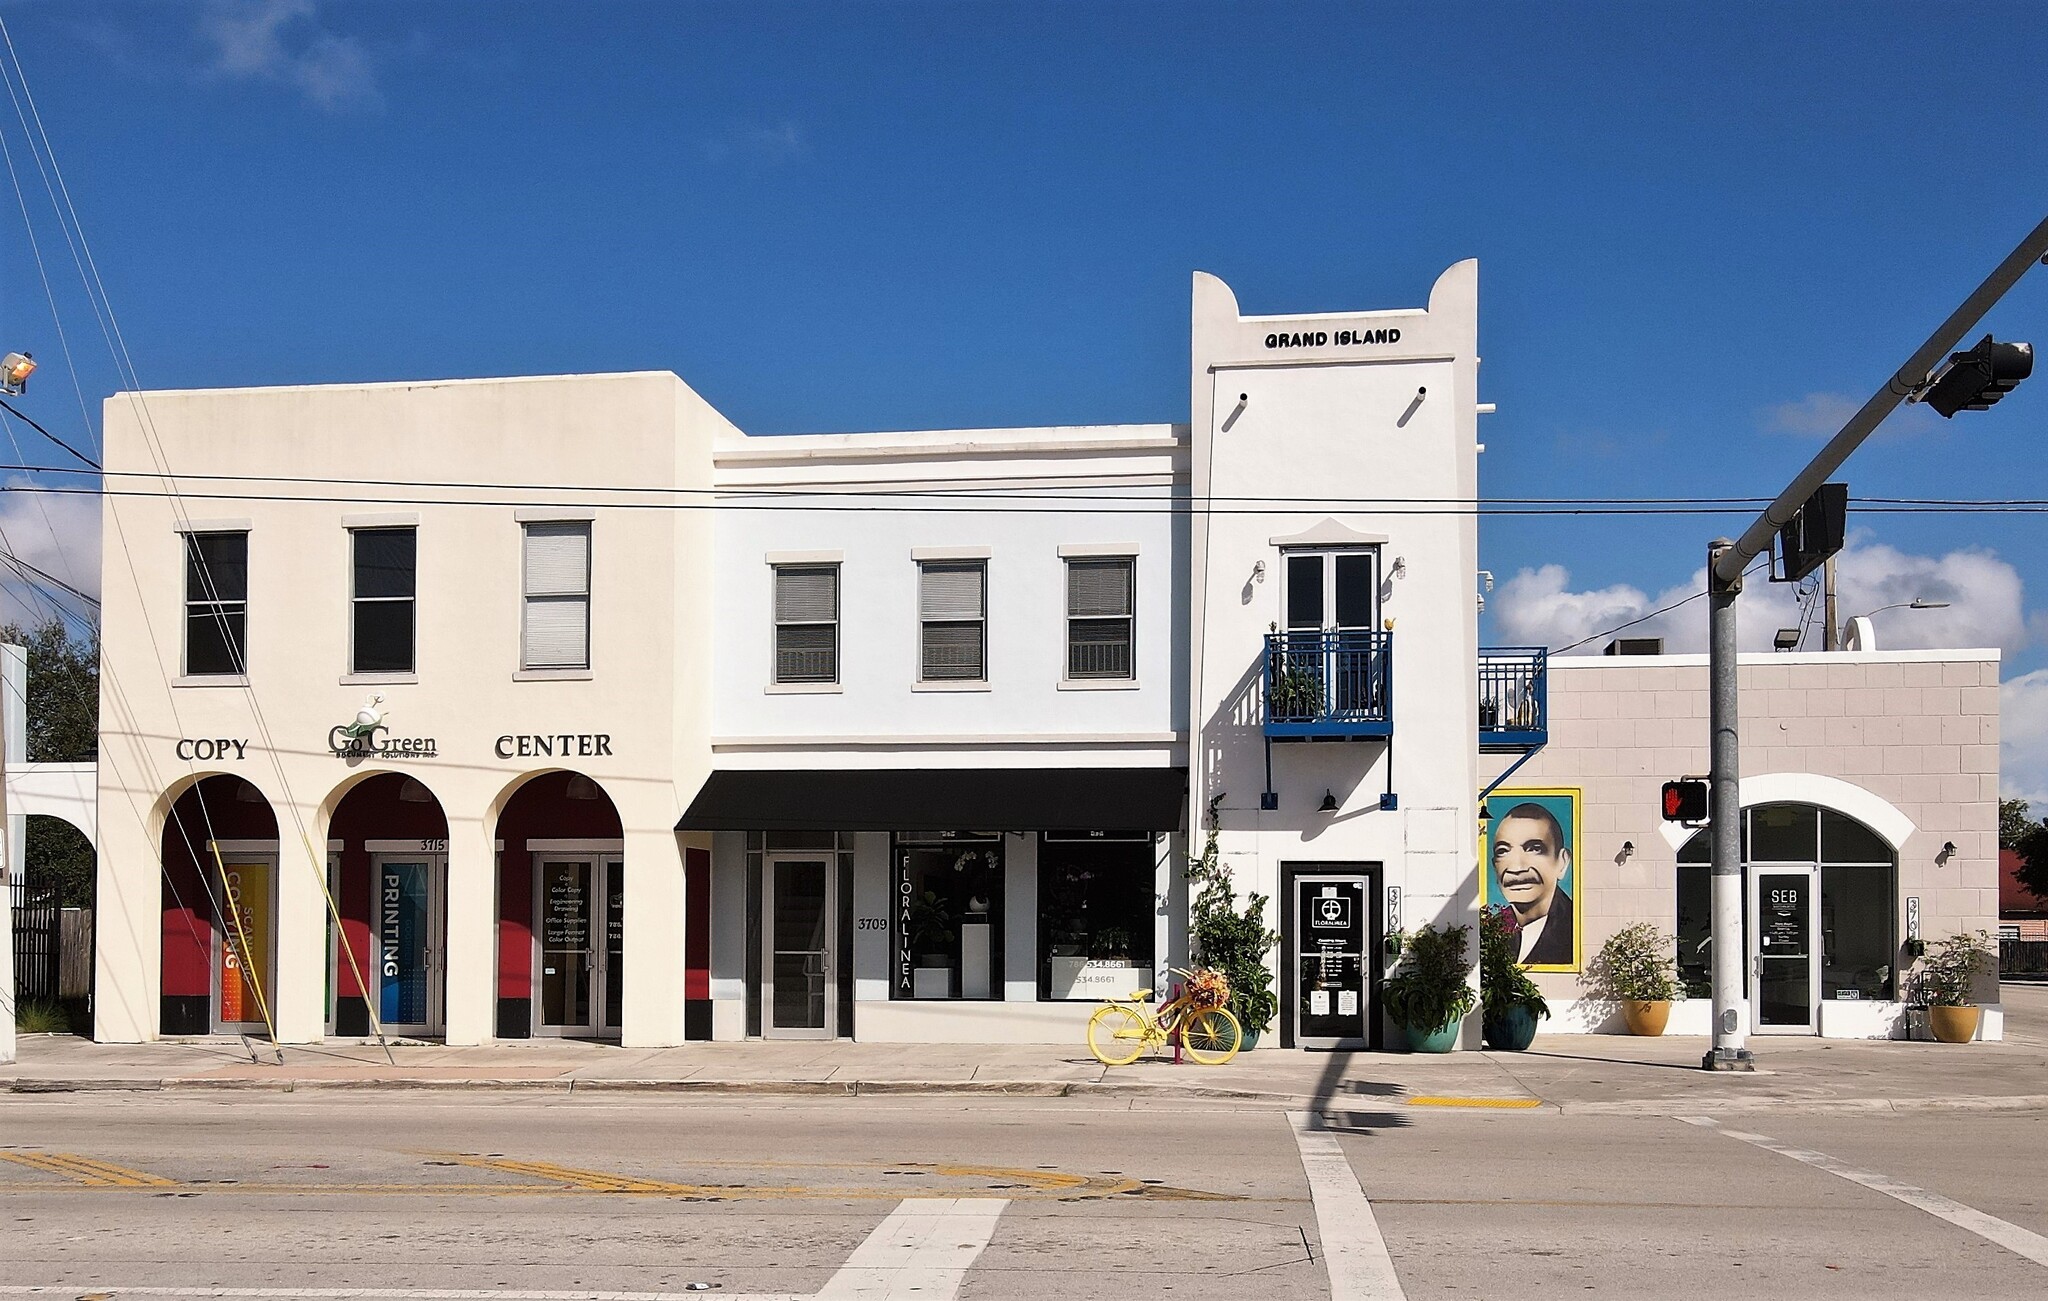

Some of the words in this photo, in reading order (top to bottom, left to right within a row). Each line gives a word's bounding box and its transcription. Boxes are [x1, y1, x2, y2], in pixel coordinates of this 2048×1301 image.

[1264, 331, 1328, 349] GRAND
[1333, 328, 1402, 346] ISLAND
[175, 738, 249, 761] COPY
[328, 725, 363, 752] Go
[367, 725, 437, 752] Green
[494, 733, 614, 760] CENTER
[420, 839, 445, 851] 3715
[1771, 889, 1797, 903] SEB
[384, 874, 400, 977] PRINTING
[857, 917, 888, 931] 3709
[900, 856, 913, 989] FLORALINEA
